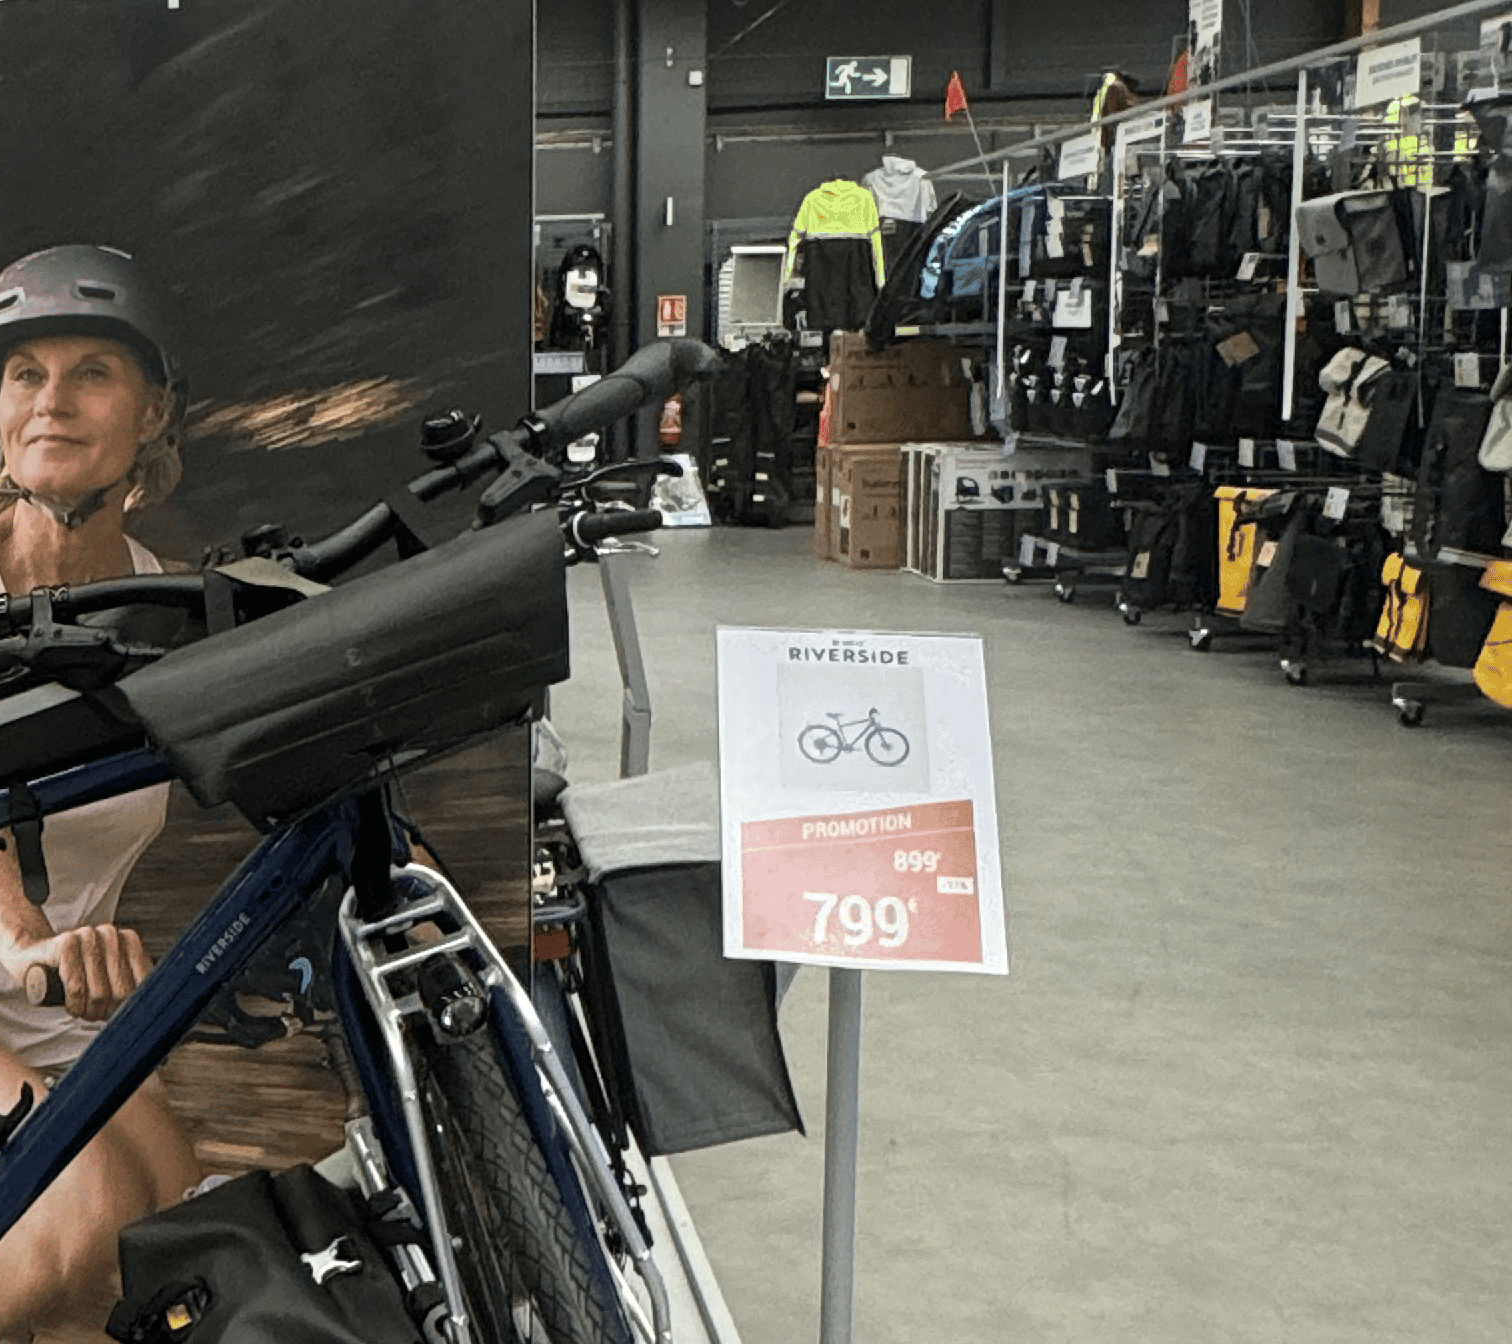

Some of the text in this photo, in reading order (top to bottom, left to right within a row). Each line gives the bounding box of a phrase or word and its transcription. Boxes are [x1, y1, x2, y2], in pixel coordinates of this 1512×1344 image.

[787, 646, 910, 666] RIVERSIDE
[802, 813, 912, 840] PROMOTION
[194, 912, 251, 973] RIVERSIDE
